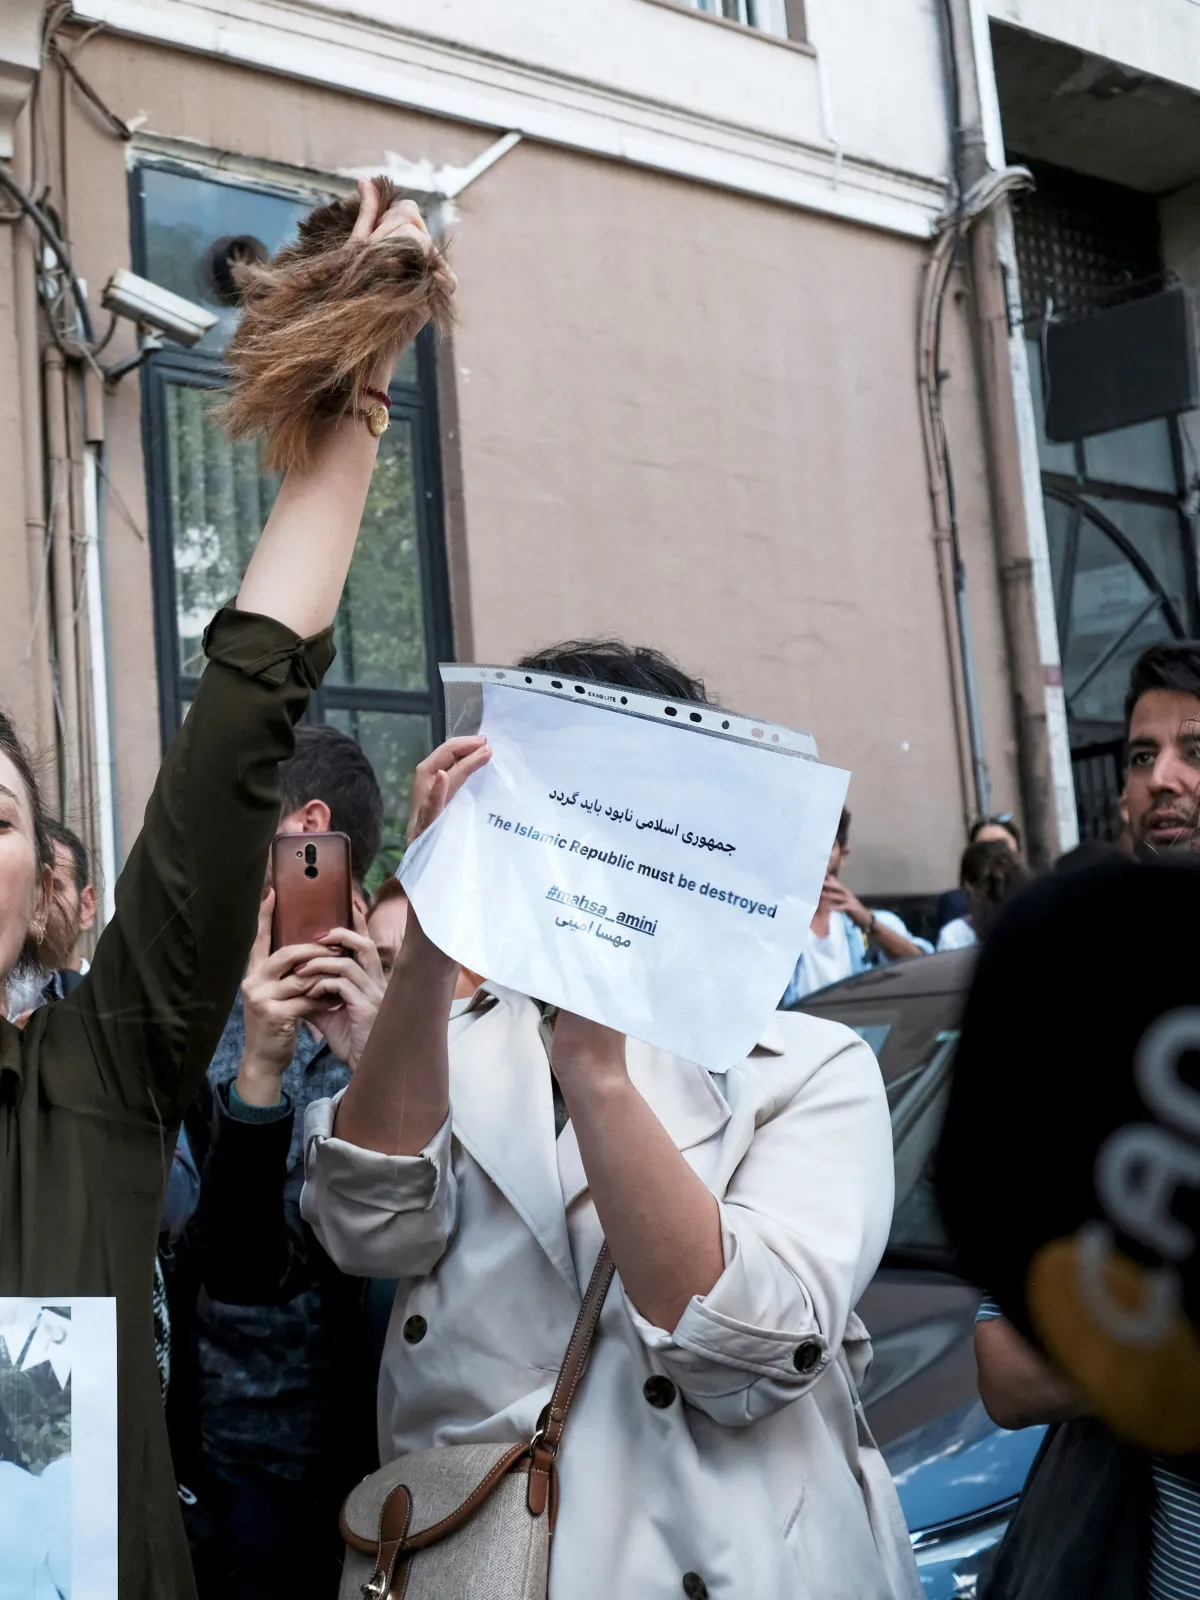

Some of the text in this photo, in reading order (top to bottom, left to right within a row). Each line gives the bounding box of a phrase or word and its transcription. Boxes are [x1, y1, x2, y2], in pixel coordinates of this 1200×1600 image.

[549, 790, 736, 856] جمهوری اسلامی نابود باید گردد
[486, 813, 778, 919] The Islamic Republic must be destroyed
[545, 885, 658, 936] #mahsa_amini
[555, 916, 631, 948] مهسا امینی
